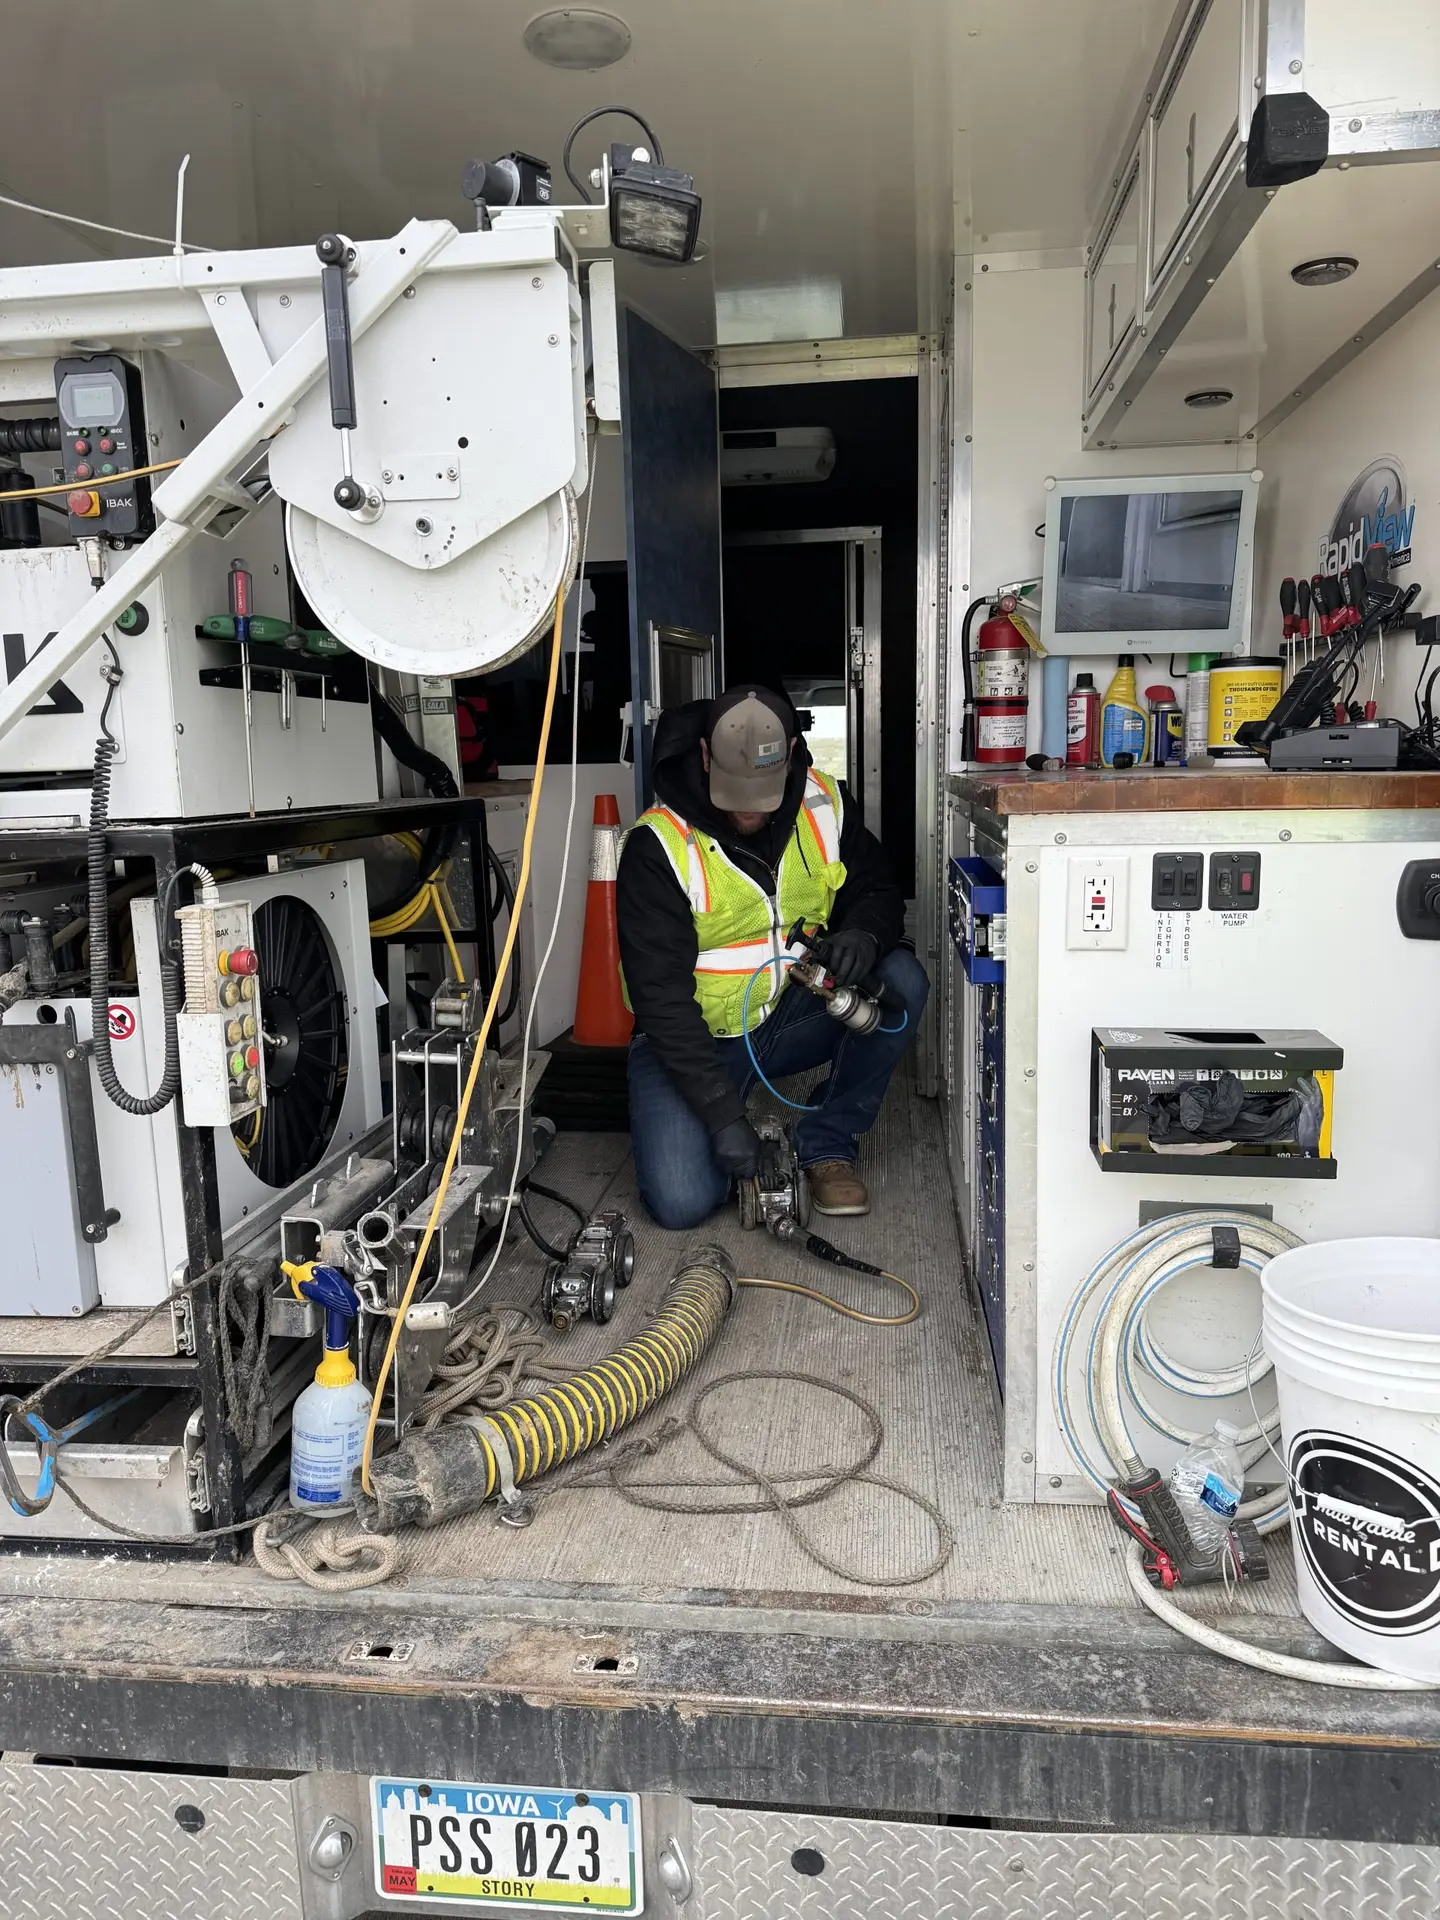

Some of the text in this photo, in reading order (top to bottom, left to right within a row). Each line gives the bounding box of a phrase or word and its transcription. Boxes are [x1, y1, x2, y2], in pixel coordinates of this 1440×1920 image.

[106, 498, 133, 508] IBAK
[1155, 912, 1163, 968] INTERIOR
[1183, 912, 1191, 961] STROBES
[1118, 1068, 1175, 1082] RAVEN
[1122, 1094, 1134, 1103] PF
[1122, 1107, 1133, 1116] EX
[1313, 1517, 1421, 1573] RENTAL
[466, 1792, 541, 1817] IOWA
[410, 1814, 601, 1883] PSS 023
[389, 1875, 416, 1887] MAY
[481, 1879, 536, 1897] STORY
